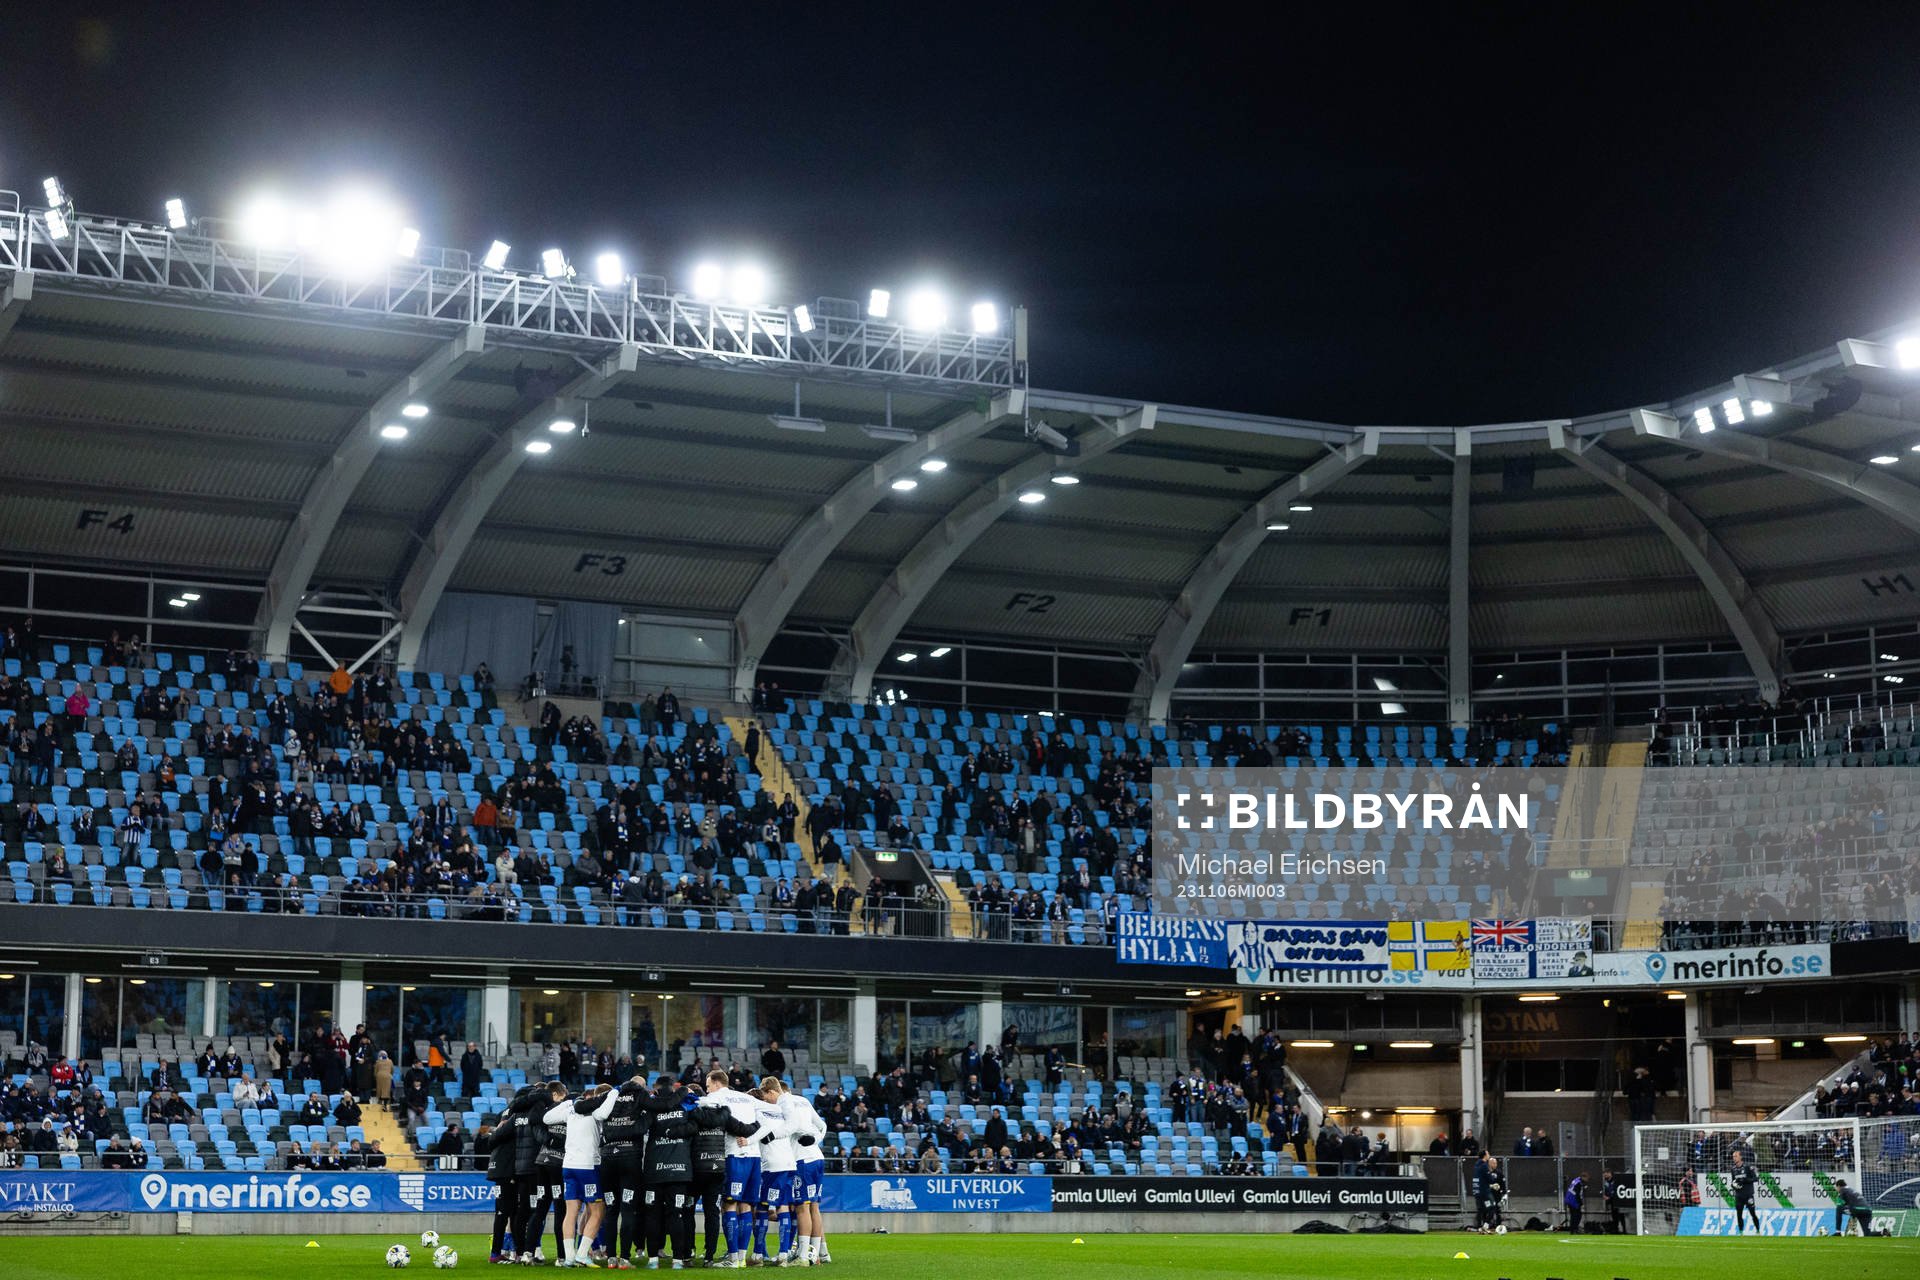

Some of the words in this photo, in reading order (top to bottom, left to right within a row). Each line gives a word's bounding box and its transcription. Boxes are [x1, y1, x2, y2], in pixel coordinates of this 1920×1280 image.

[77, 509, 134, 534] F4
[574, 552, 627, 576] F3
[1862, 572, 1916, 599] H1
[1005, 592, 1056, 613] F2
[1290, 607, 1332, 627] F1
[1119, 914, 1225, 941] BEBBENS
[1476, 944, 1516, 952] LITTLE
[1520, 942, 1590, 951] LONDONERS
[1673, 950, 1823, 979] merinfo.se
[170, 1174, 371, 1208] merinfo.se
[926, 1179, 1025, 1194] SILFVERLOK
[1096, 1188, 1136, 1203] Ullevi
[1145, 1189, 1191, 1203] Gamla
[1195, 1188, 1235, 1203] Ullevi
[1243, 1189, 1289, 1203] Gamla
[1292, 1189, 1331, 1204] Ullevi
[1338, 1190, 1383, 1204] Gamla
[1386, 1190, 1424, 1204] Ullevi
[1653, 1184, 1681, 1200] Ullev
[34, 1203, 74, 1212] INSTALCO
[952, 1198, 1000, 1209] INVEST
